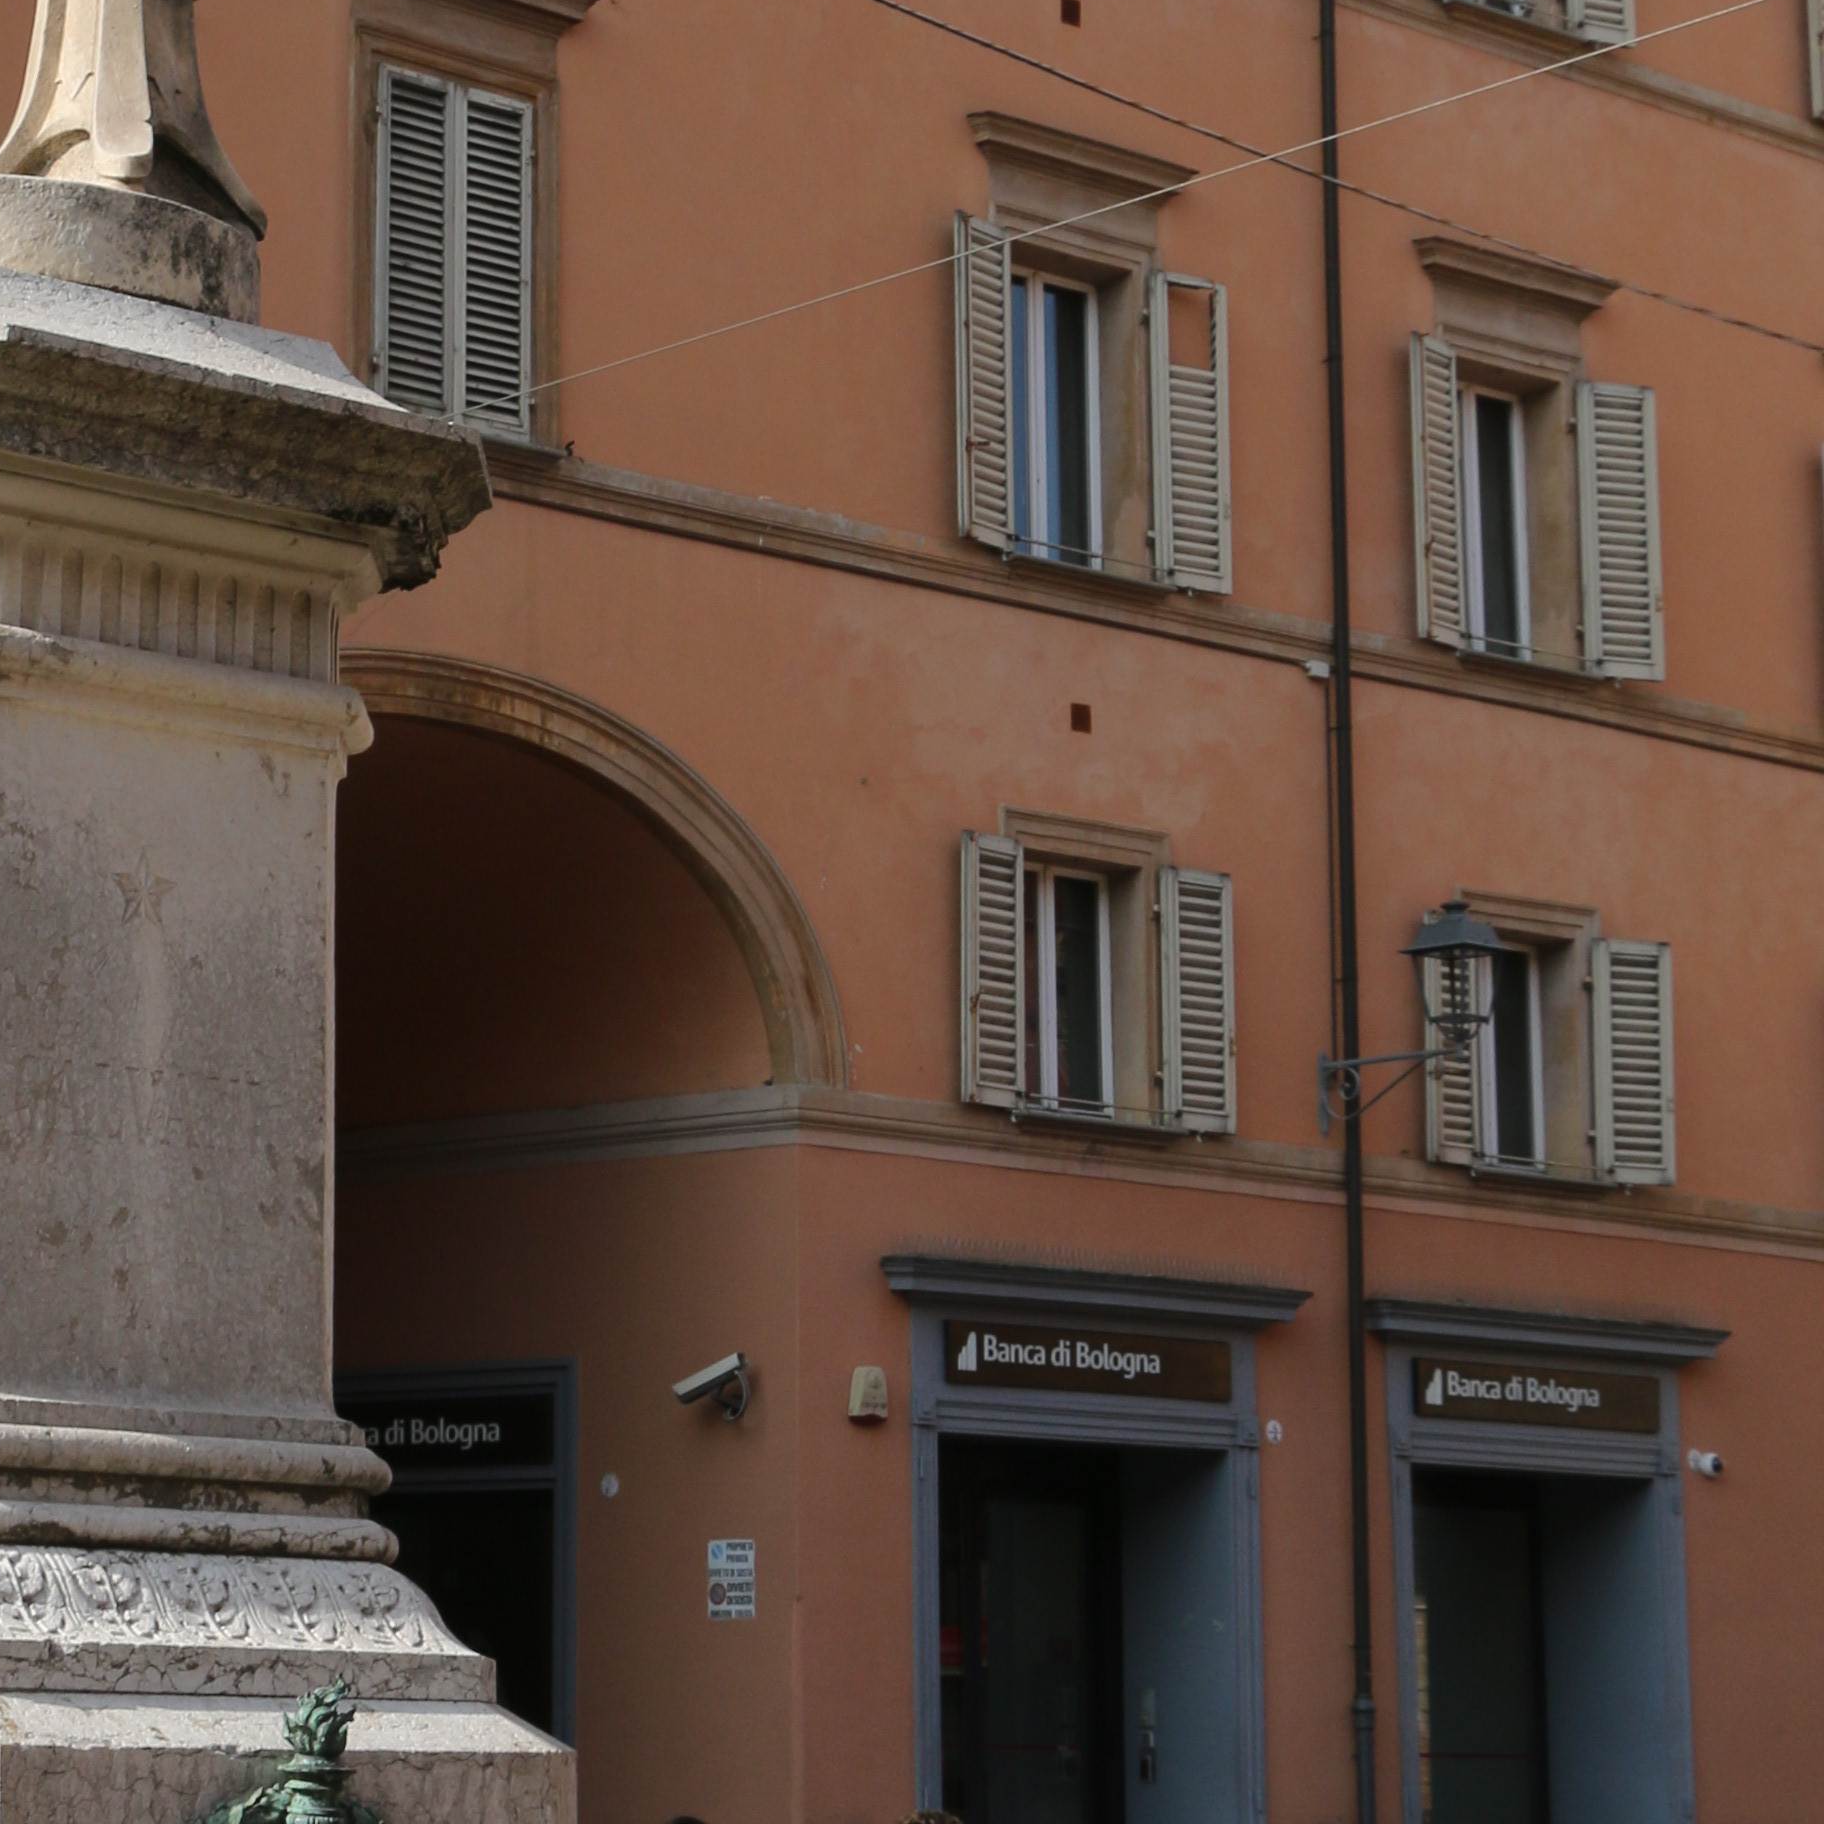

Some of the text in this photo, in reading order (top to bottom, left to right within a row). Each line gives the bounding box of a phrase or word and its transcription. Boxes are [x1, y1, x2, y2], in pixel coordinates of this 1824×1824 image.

[983, 1334, 1161, 1379] Banca di Bologna
[1447, 1371, 1600, 1412] Banca di Bologna
[385, 1419, 405, 1445] di
[411, 1417, 501, 1450] Bologna
